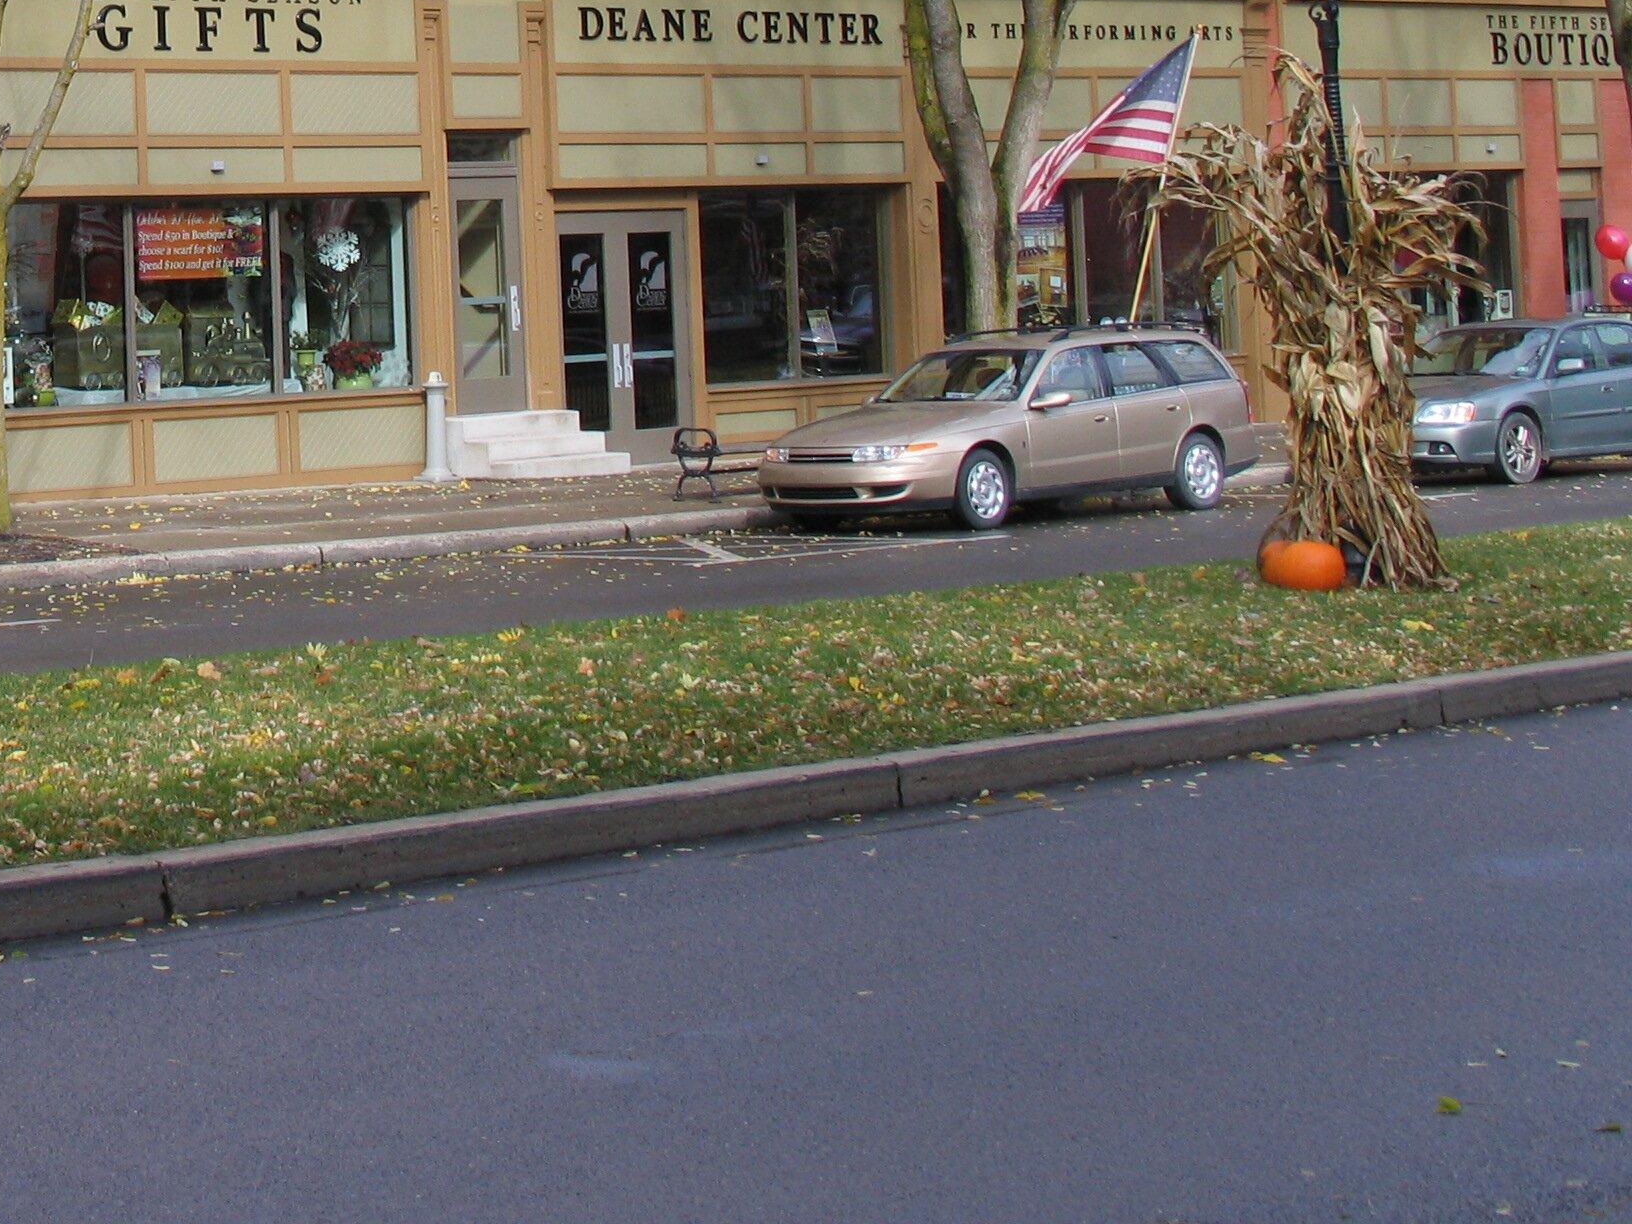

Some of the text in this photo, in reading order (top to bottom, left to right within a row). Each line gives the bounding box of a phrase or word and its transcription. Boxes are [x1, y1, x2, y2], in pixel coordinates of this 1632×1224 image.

[95, 4, 324, 54] GIFTS
[578, 7, 883, 45] DEANE CENTER
[1486, 15, 1518, 29] THE
[1530, 16, 1580, 30] FIFTH
[990, 23, 1025, 39] TH
[1062, 24, 1176, 41] RFORMING
[1489, 32, 1611, 67] BOUTIQ
[138, 230, 163, 243] Spend
[165, 230, 181, 242] $50
[182, 230, 190, 239] in
[191, 229, 227, 242] Boutique
[138, 245, 165, 256] choose
[167, 247, 172, 255] a
[174, 244, 192, 255] scarf
[193, 244, 205, 255] for
[139, 256, 262, 273] Spend $100 and get it for FREE!
